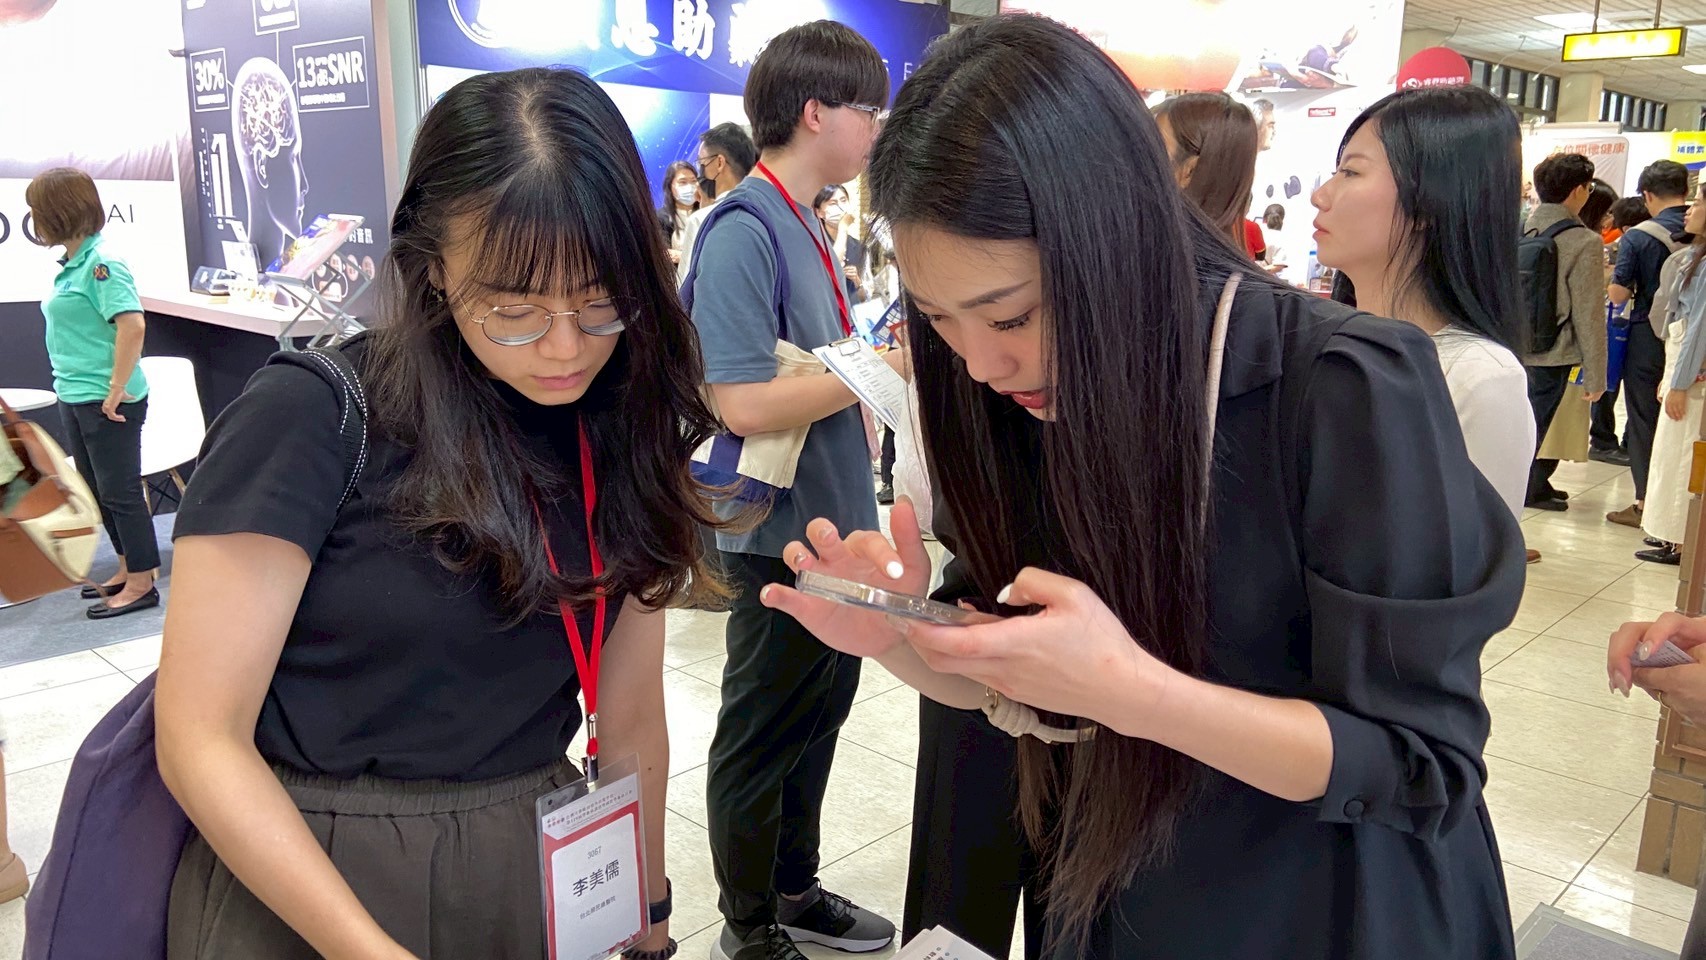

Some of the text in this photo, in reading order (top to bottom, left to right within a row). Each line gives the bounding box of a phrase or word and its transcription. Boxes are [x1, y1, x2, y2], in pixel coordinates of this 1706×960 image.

[194, 58, 225, 92] 30%
[327, 51, 365, 84] SNR
[107, 204, 134, 223] AI
